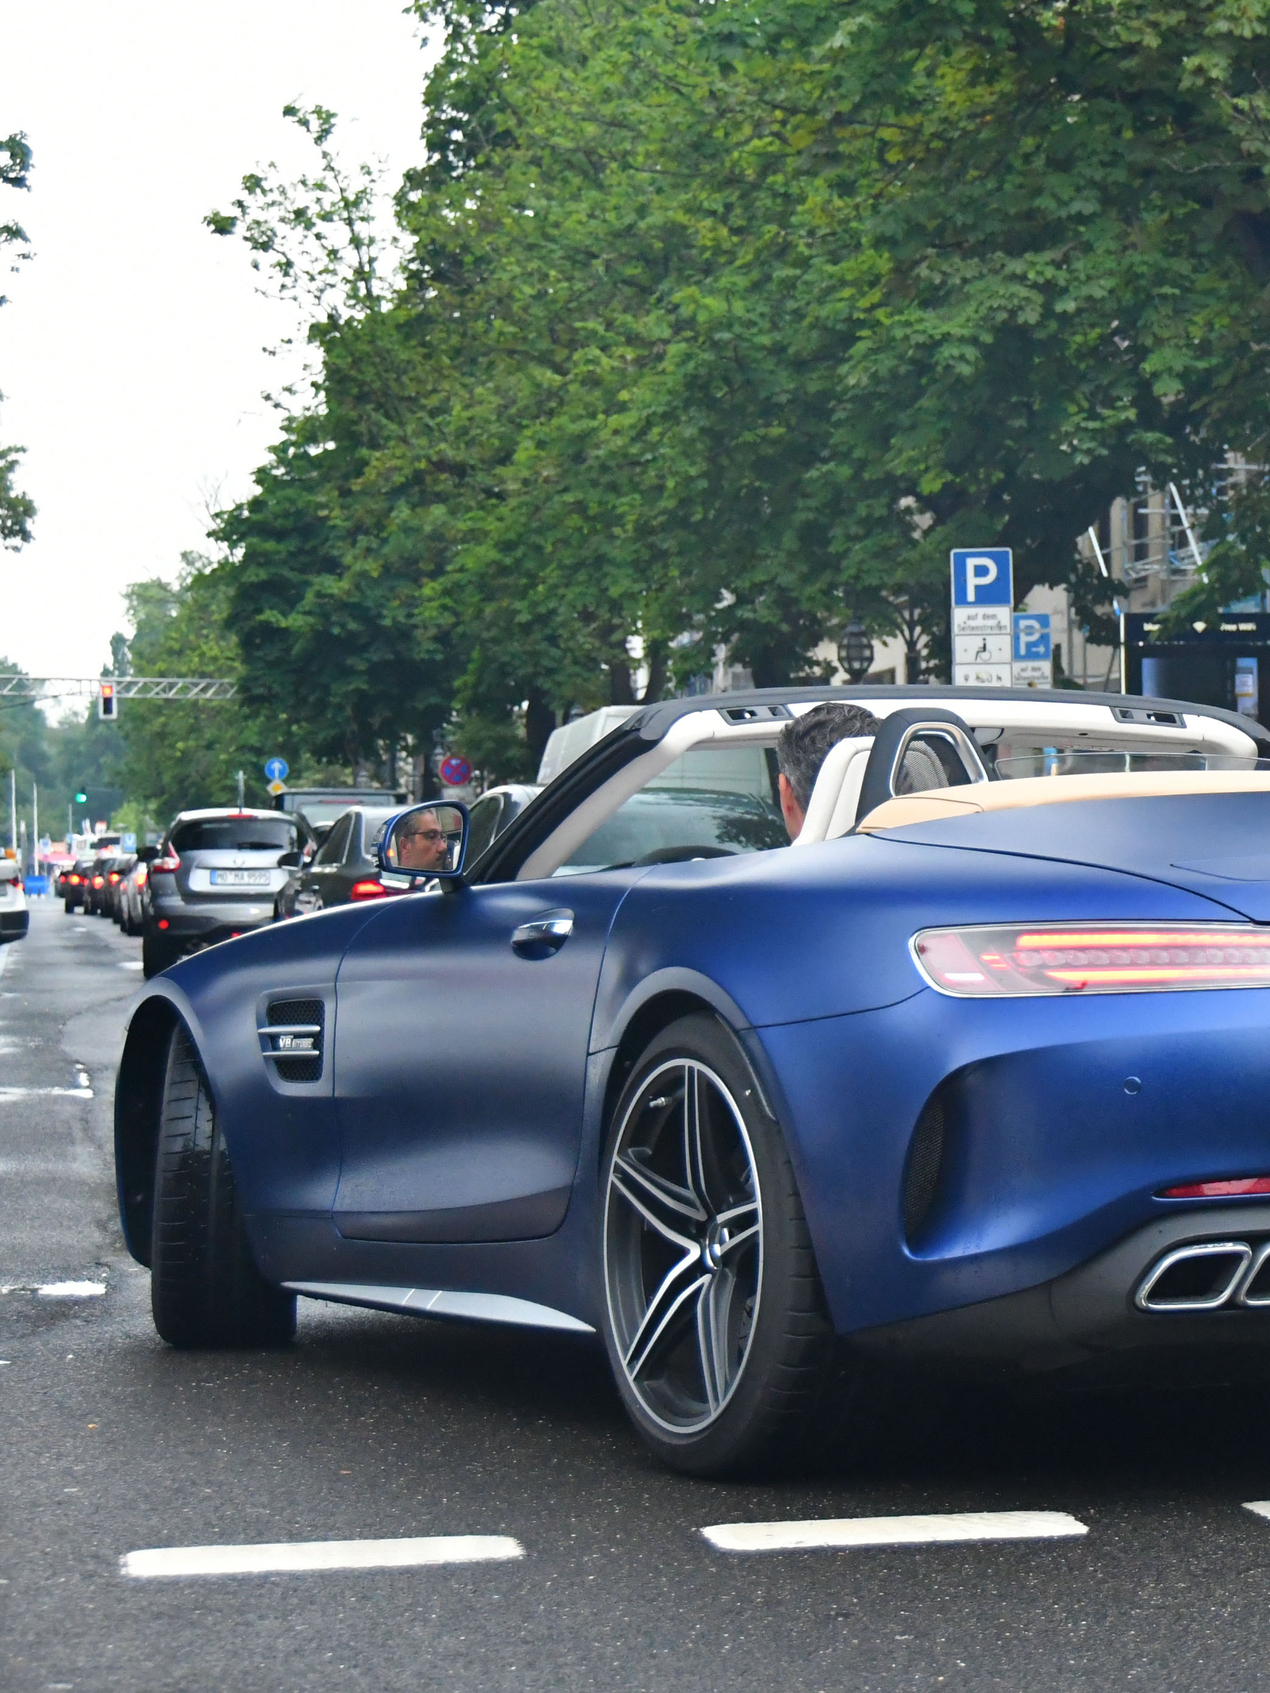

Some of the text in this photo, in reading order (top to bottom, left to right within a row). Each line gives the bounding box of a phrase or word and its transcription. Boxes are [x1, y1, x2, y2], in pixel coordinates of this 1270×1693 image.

[965, 556, 998, 602] P
[967, 612, 997, 621] auf dem
[1018, 618, 1041, 656] P
